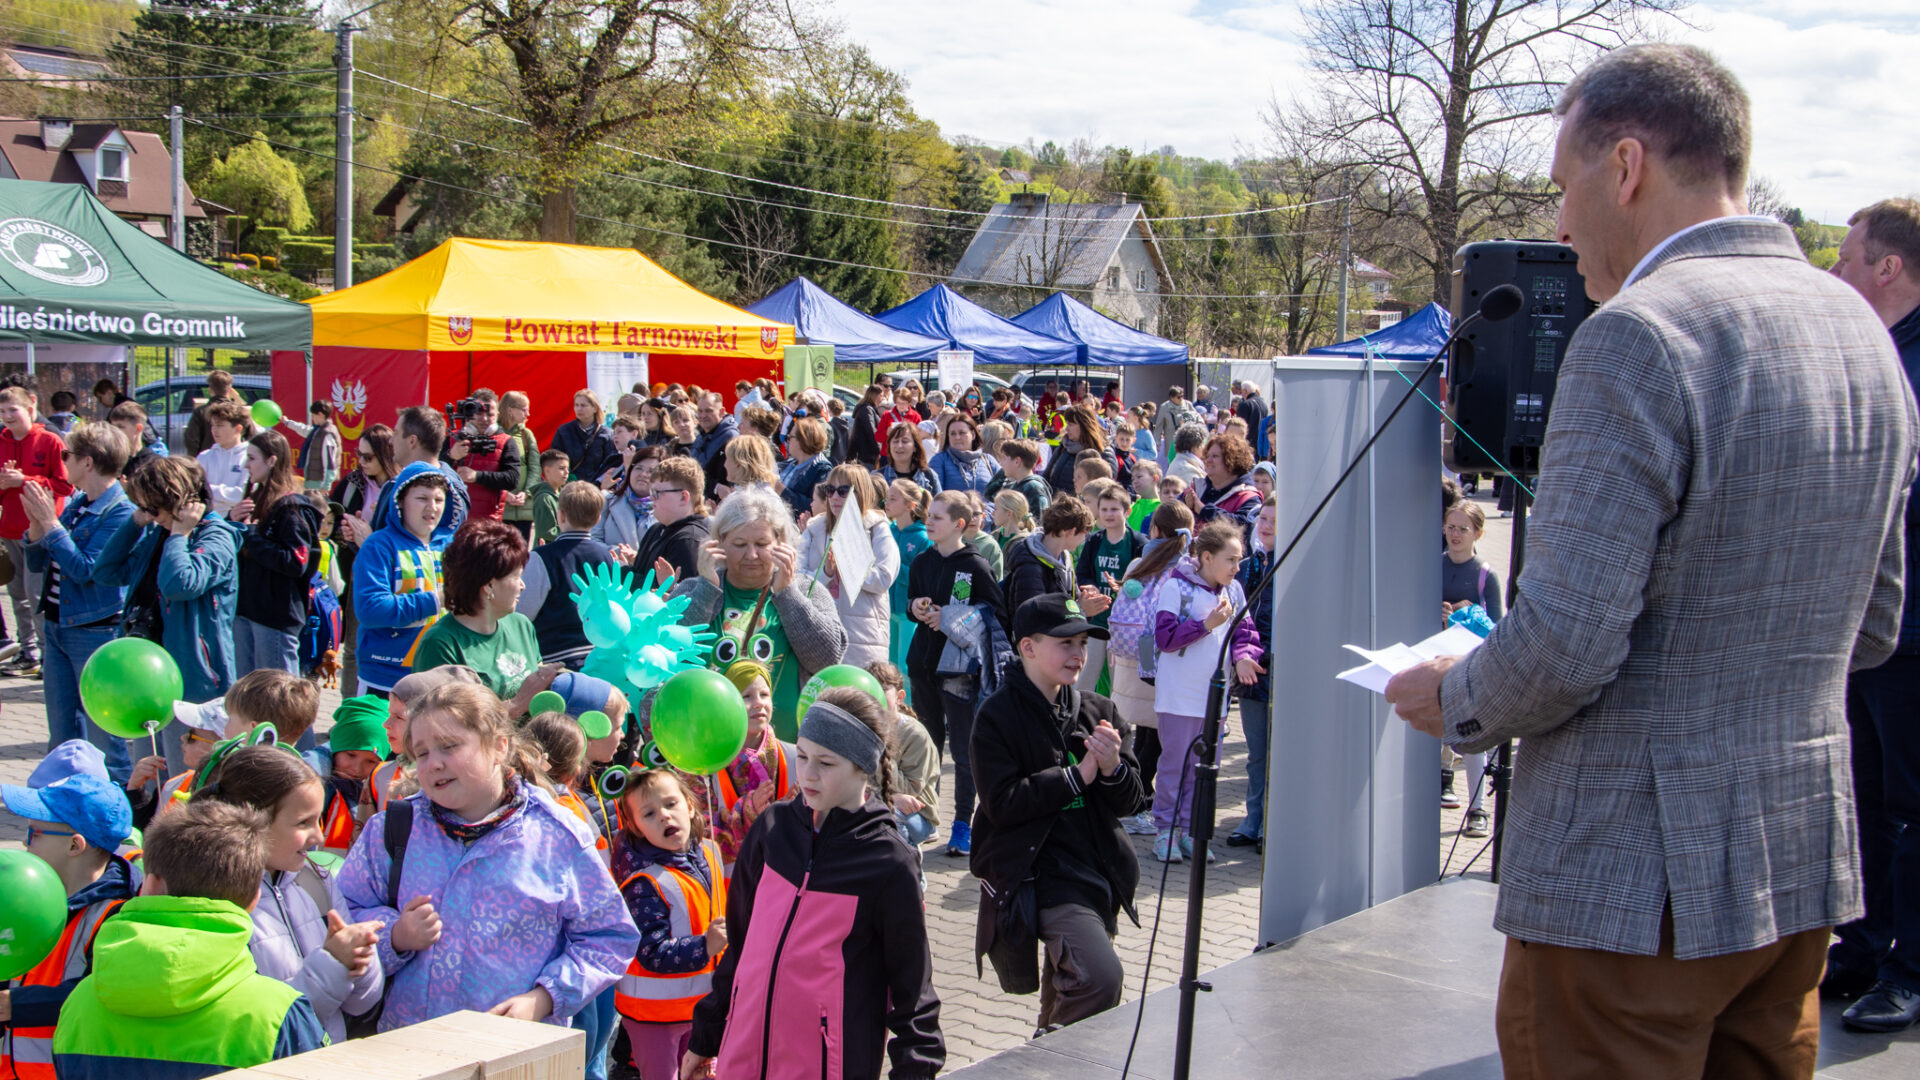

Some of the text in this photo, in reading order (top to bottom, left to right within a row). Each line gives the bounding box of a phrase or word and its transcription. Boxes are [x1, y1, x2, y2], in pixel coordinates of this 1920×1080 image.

[142, 312, 247, 338] Gromnik
[503, 317, 739, 351] Powiat Tarnowski
